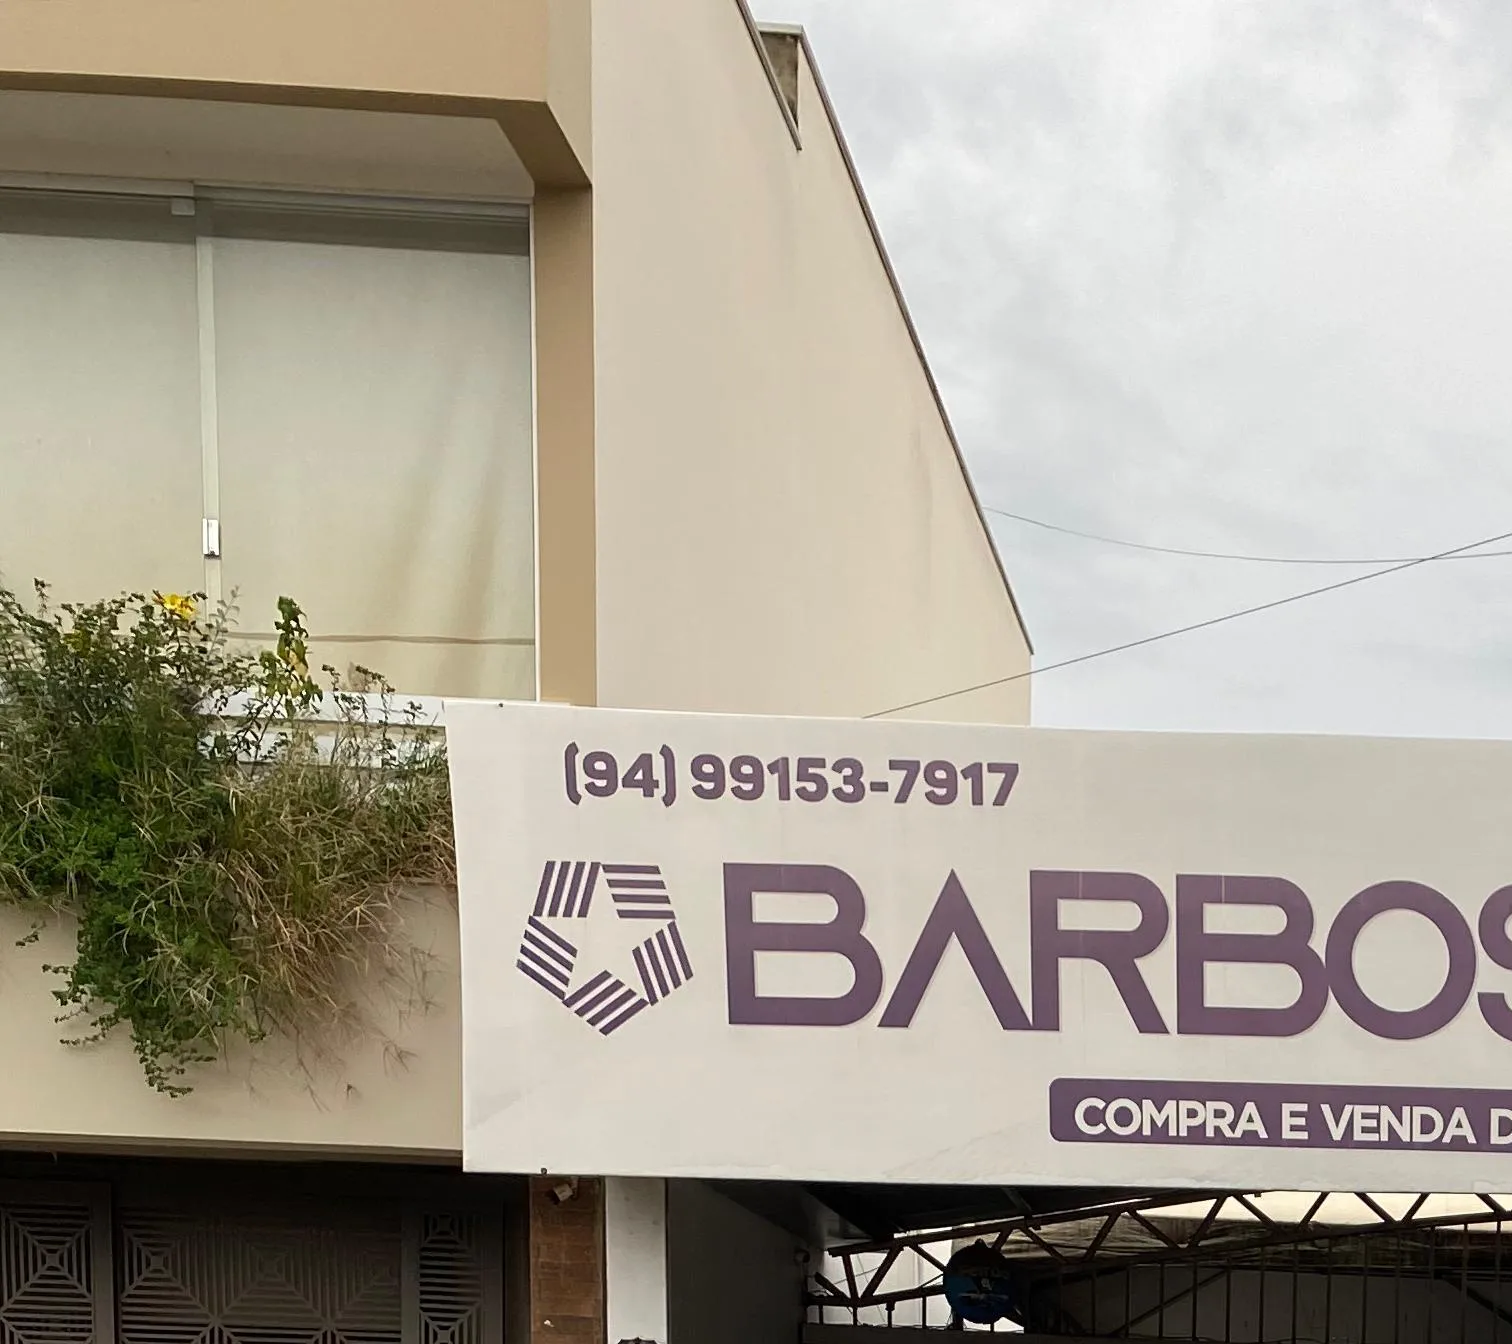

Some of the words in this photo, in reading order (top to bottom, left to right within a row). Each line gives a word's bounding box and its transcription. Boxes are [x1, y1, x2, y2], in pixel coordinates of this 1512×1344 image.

[564, 741, 677, 808] (94)
[690, 753, 1020, 807] 99153-7917
[1073, 1097, 1269, 1140] COMPRA
[1280, 1102, 1309, 1140] E
[1320, 1104, 1477, 1145] VENDA
